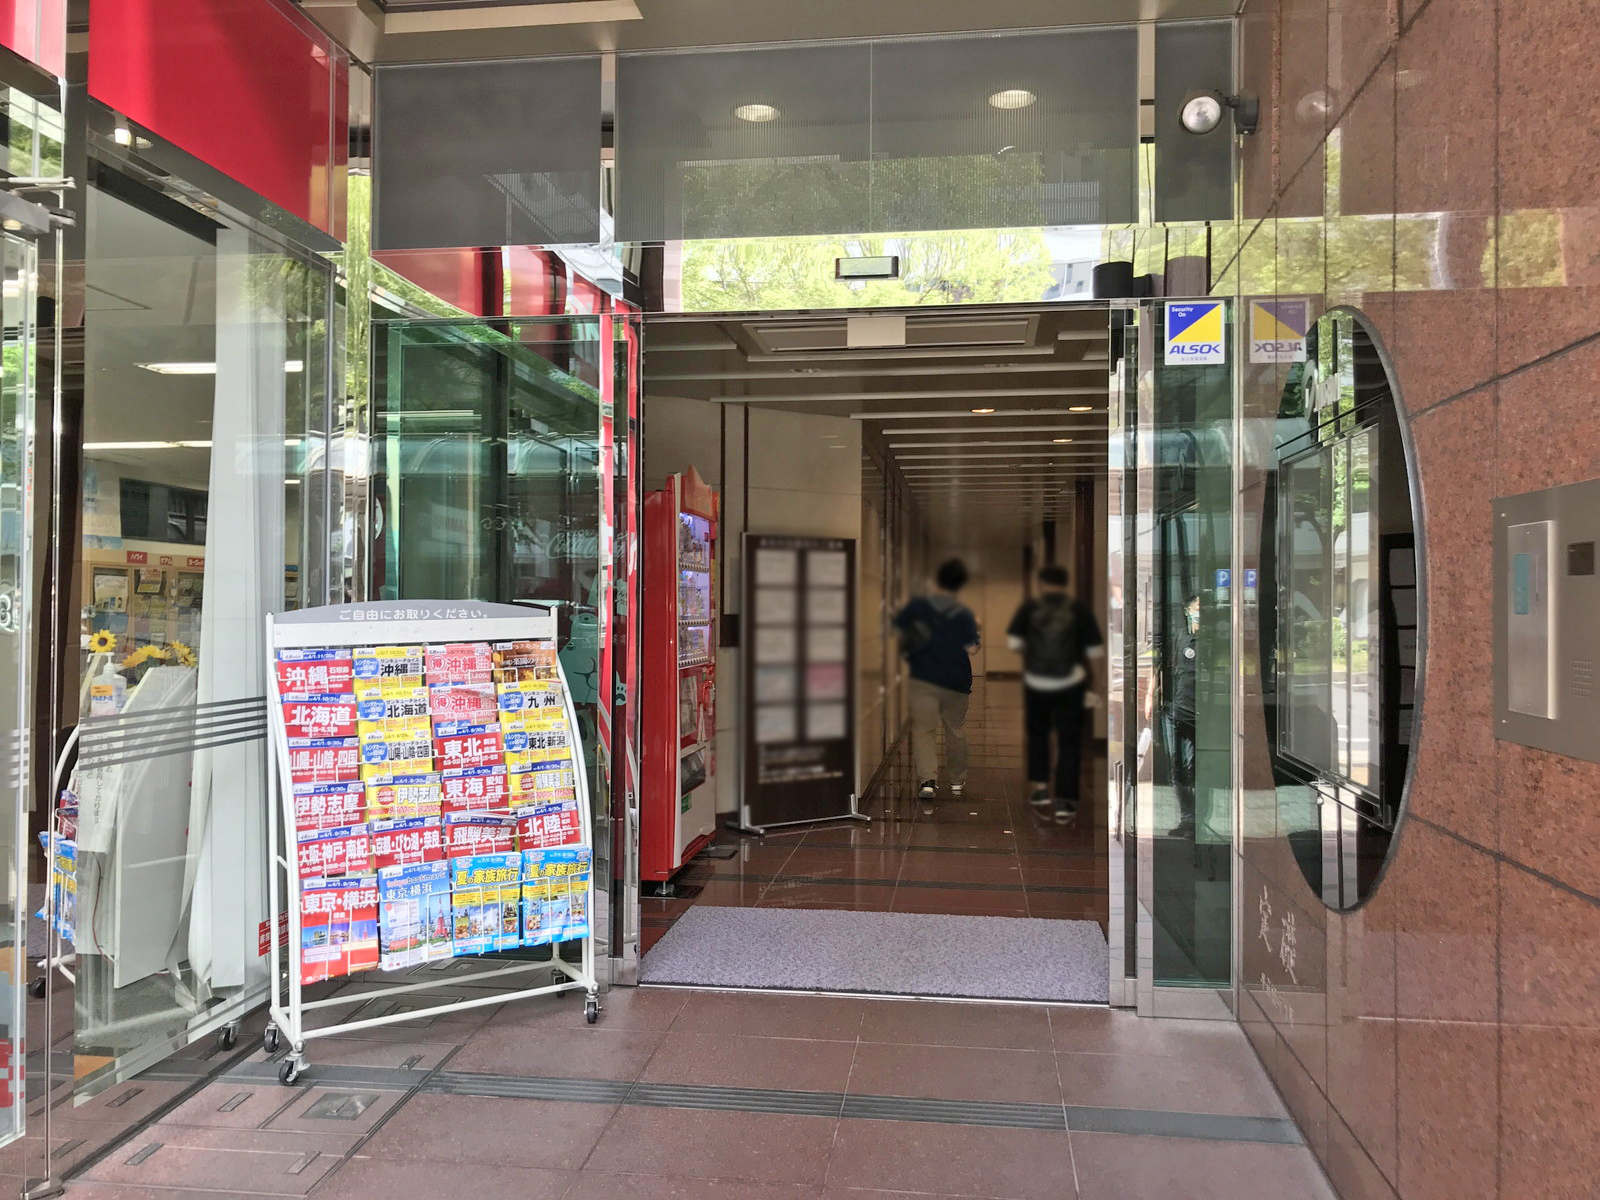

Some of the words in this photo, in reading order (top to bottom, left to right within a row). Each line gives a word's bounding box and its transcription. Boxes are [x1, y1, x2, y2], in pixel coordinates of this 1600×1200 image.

[1169, 344, 1221, 355] ALSOK
[1218, 571, 1228, 585] P
[339, 608, 488, 621] ご自由にお取りください。
[380, 663, 408, 677] 沖縄
[446, 656, 477, 672] 沖縄
[285, 666, 328, 687] 沖縄
[387, 703, 427, 718] 北海道
[451, 696, 482, 711] 沖縄
[527, 695, 556, 709] 九州
[290, 705, 351, 726] 北海道
[443, 737, 482, 759] 東北
[397, 786, 440, 804] 伊勢志摩
[445, 777, 484, 798] 東海
[294, 794, 359, 816] 伊勢志摩
[524, 813, 562, 837] 北陸
[456, 867, 519, 886] 夏の家族旅行
[529, 861, 588, 878] 夏の家族旅行
[385, 881, 433, 900] 東京・横浜
[303, 889, 376, 914] 東京・横浜
